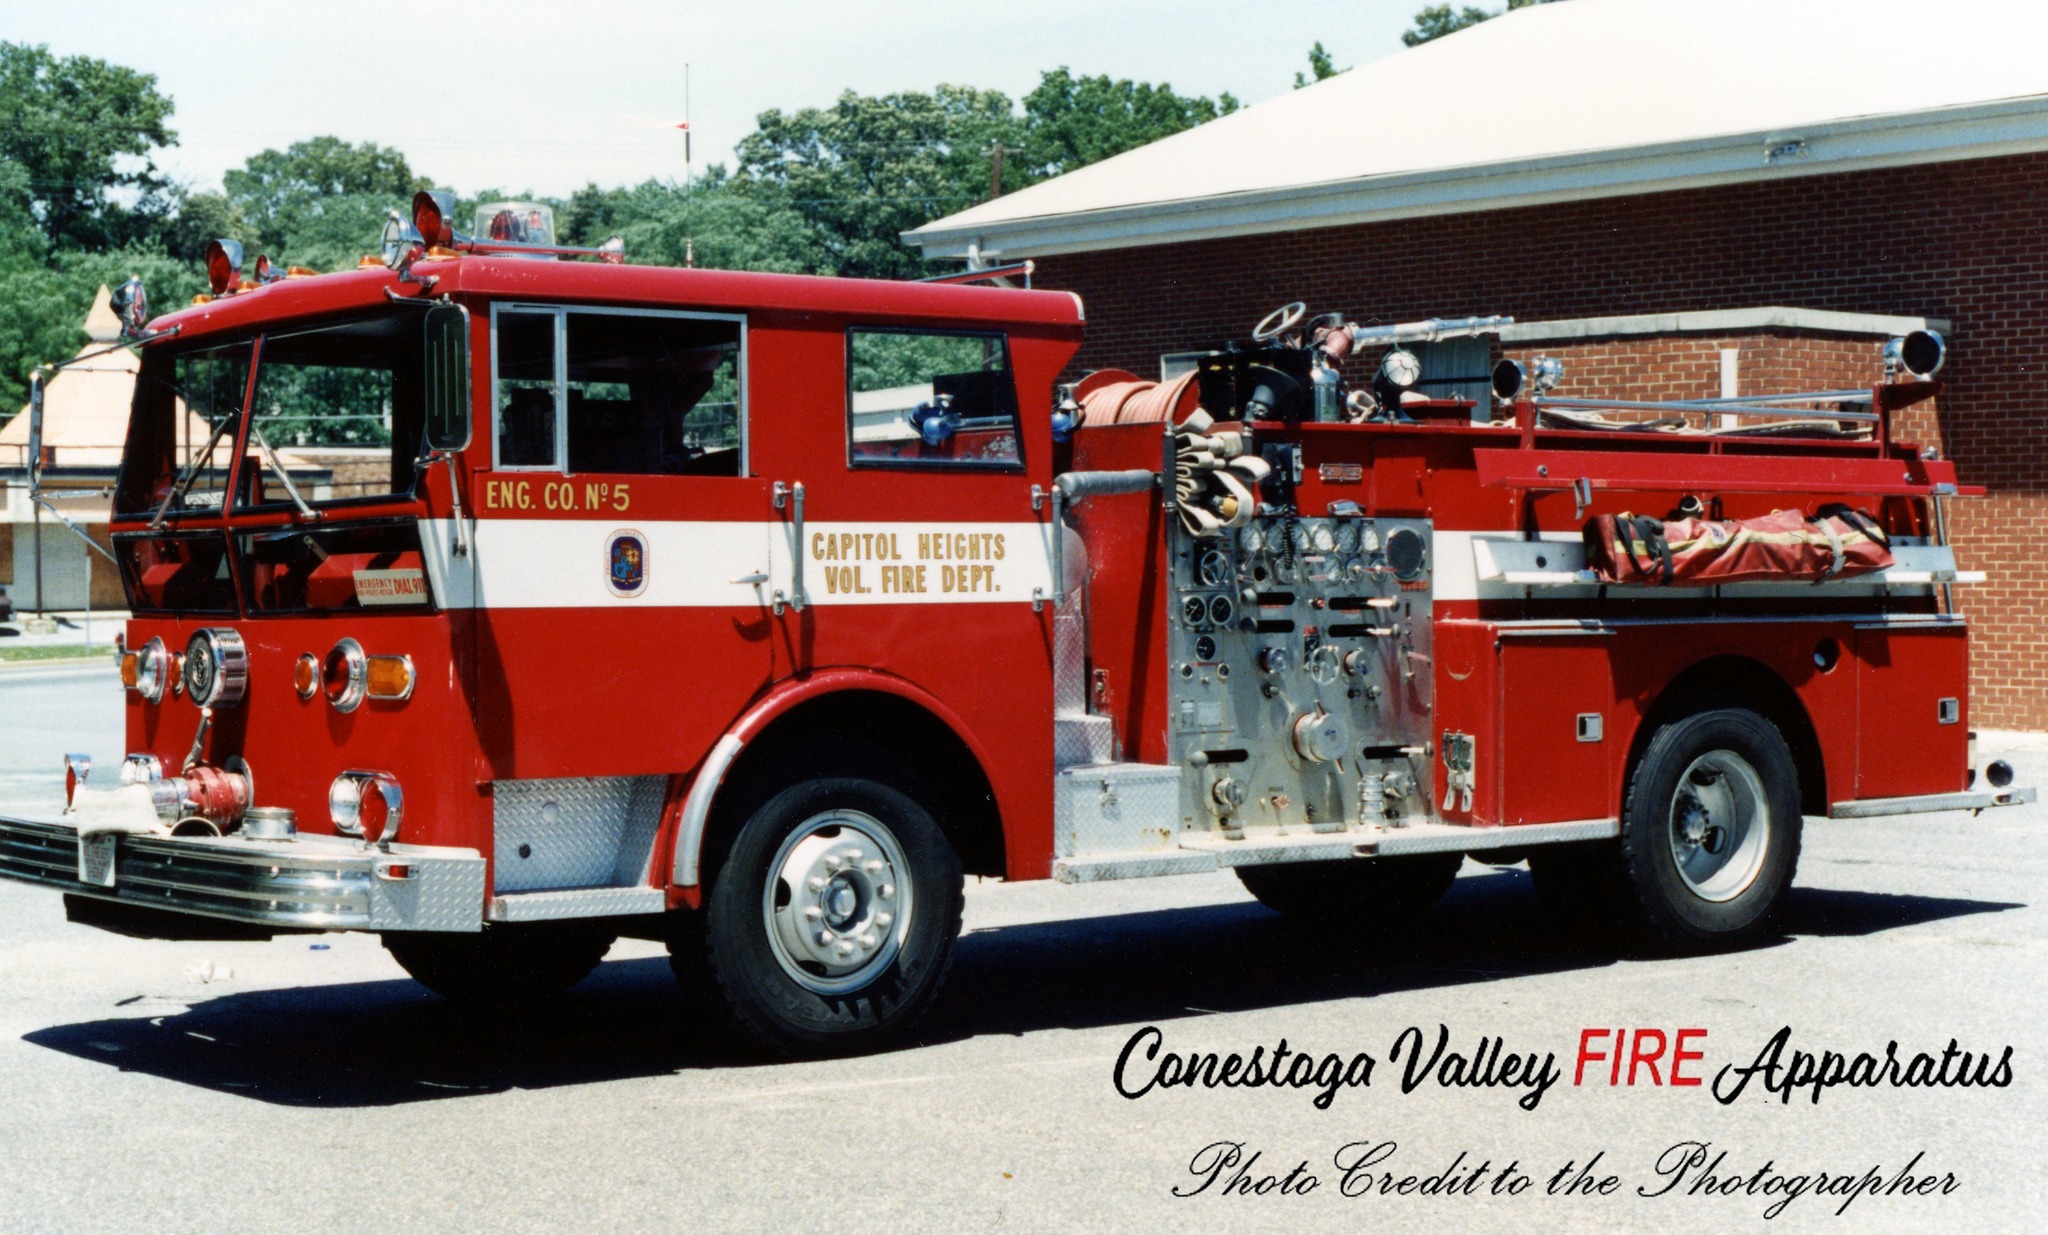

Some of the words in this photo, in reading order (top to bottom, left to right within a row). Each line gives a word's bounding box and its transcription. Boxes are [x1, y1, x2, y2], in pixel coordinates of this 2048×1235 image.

[486, 481, 536, 509] ENG.
[544, 482, 578, 511] CO.
[612, 484, 630, 511] 5
[811, 532, 902, 560] CAPITOL
[918, 533, 1006, 560] HEIGHTS
[355, 577, 392, 589] EMERGENCY
[394, 577, 413, 594] DIAL
[824, 565, 872, 594] VOL.
[881, 565, 927, 593] FIRE
[941, 564, 1001, 593] DEPT.
